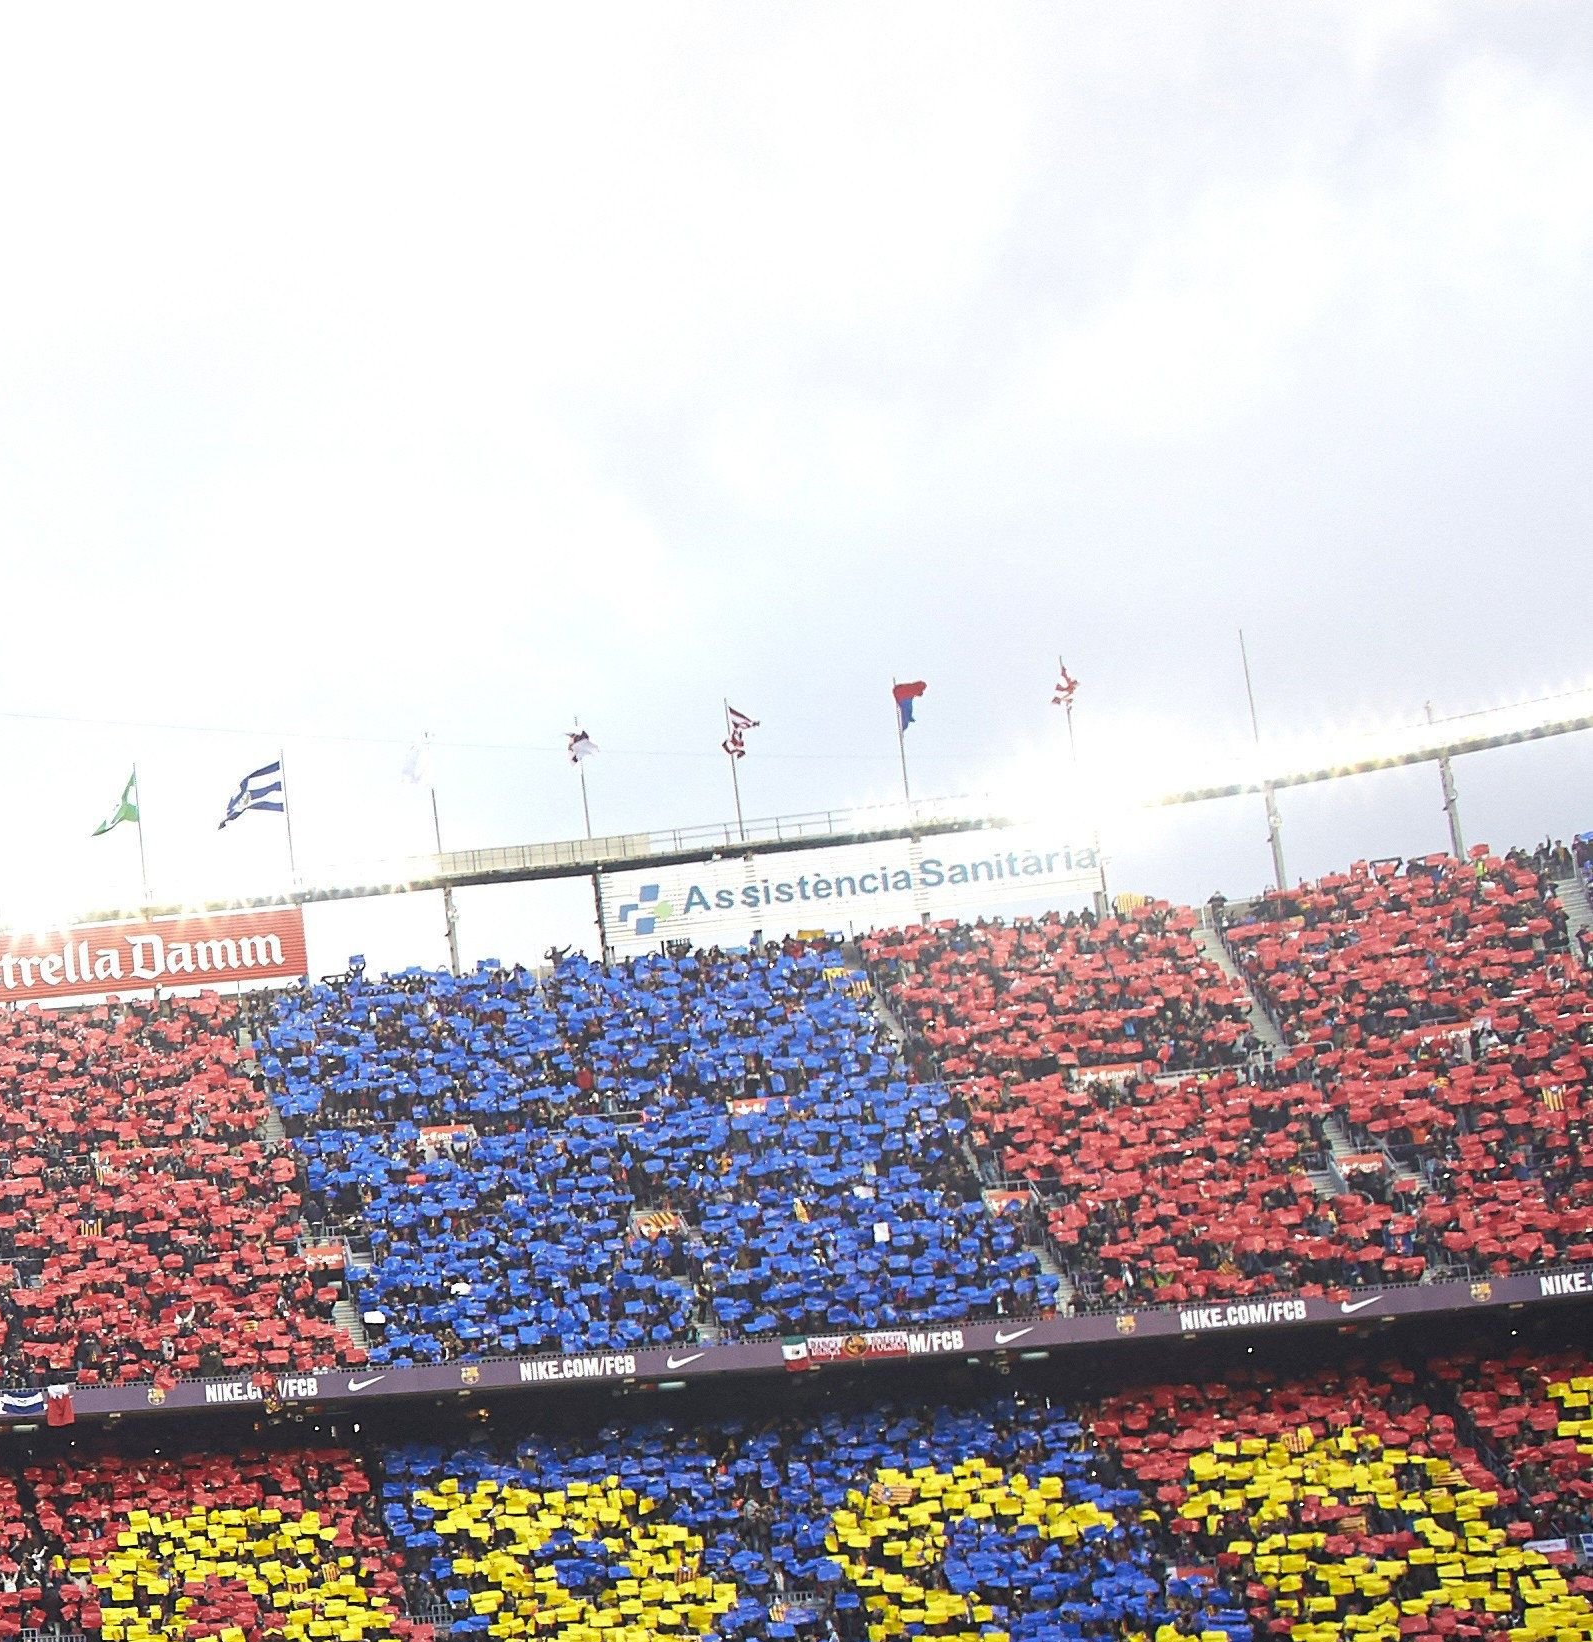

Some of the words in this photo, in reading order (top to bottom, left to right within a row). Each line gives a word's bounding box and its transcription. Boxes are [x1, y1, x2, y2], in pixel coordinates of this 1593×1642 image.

[681, 866, 913, 915] Assistència
[918, 847, 1098, 888] Sanitària
[125, 932, 287, 981] Damm
[1179, 1299, 1307, 1331] NIKE.COM/FCB
[519, 1354, 636, 1382] NIKE.COM/FCB
[205, 1377, 319, 1402] NIKE.C/FCB
